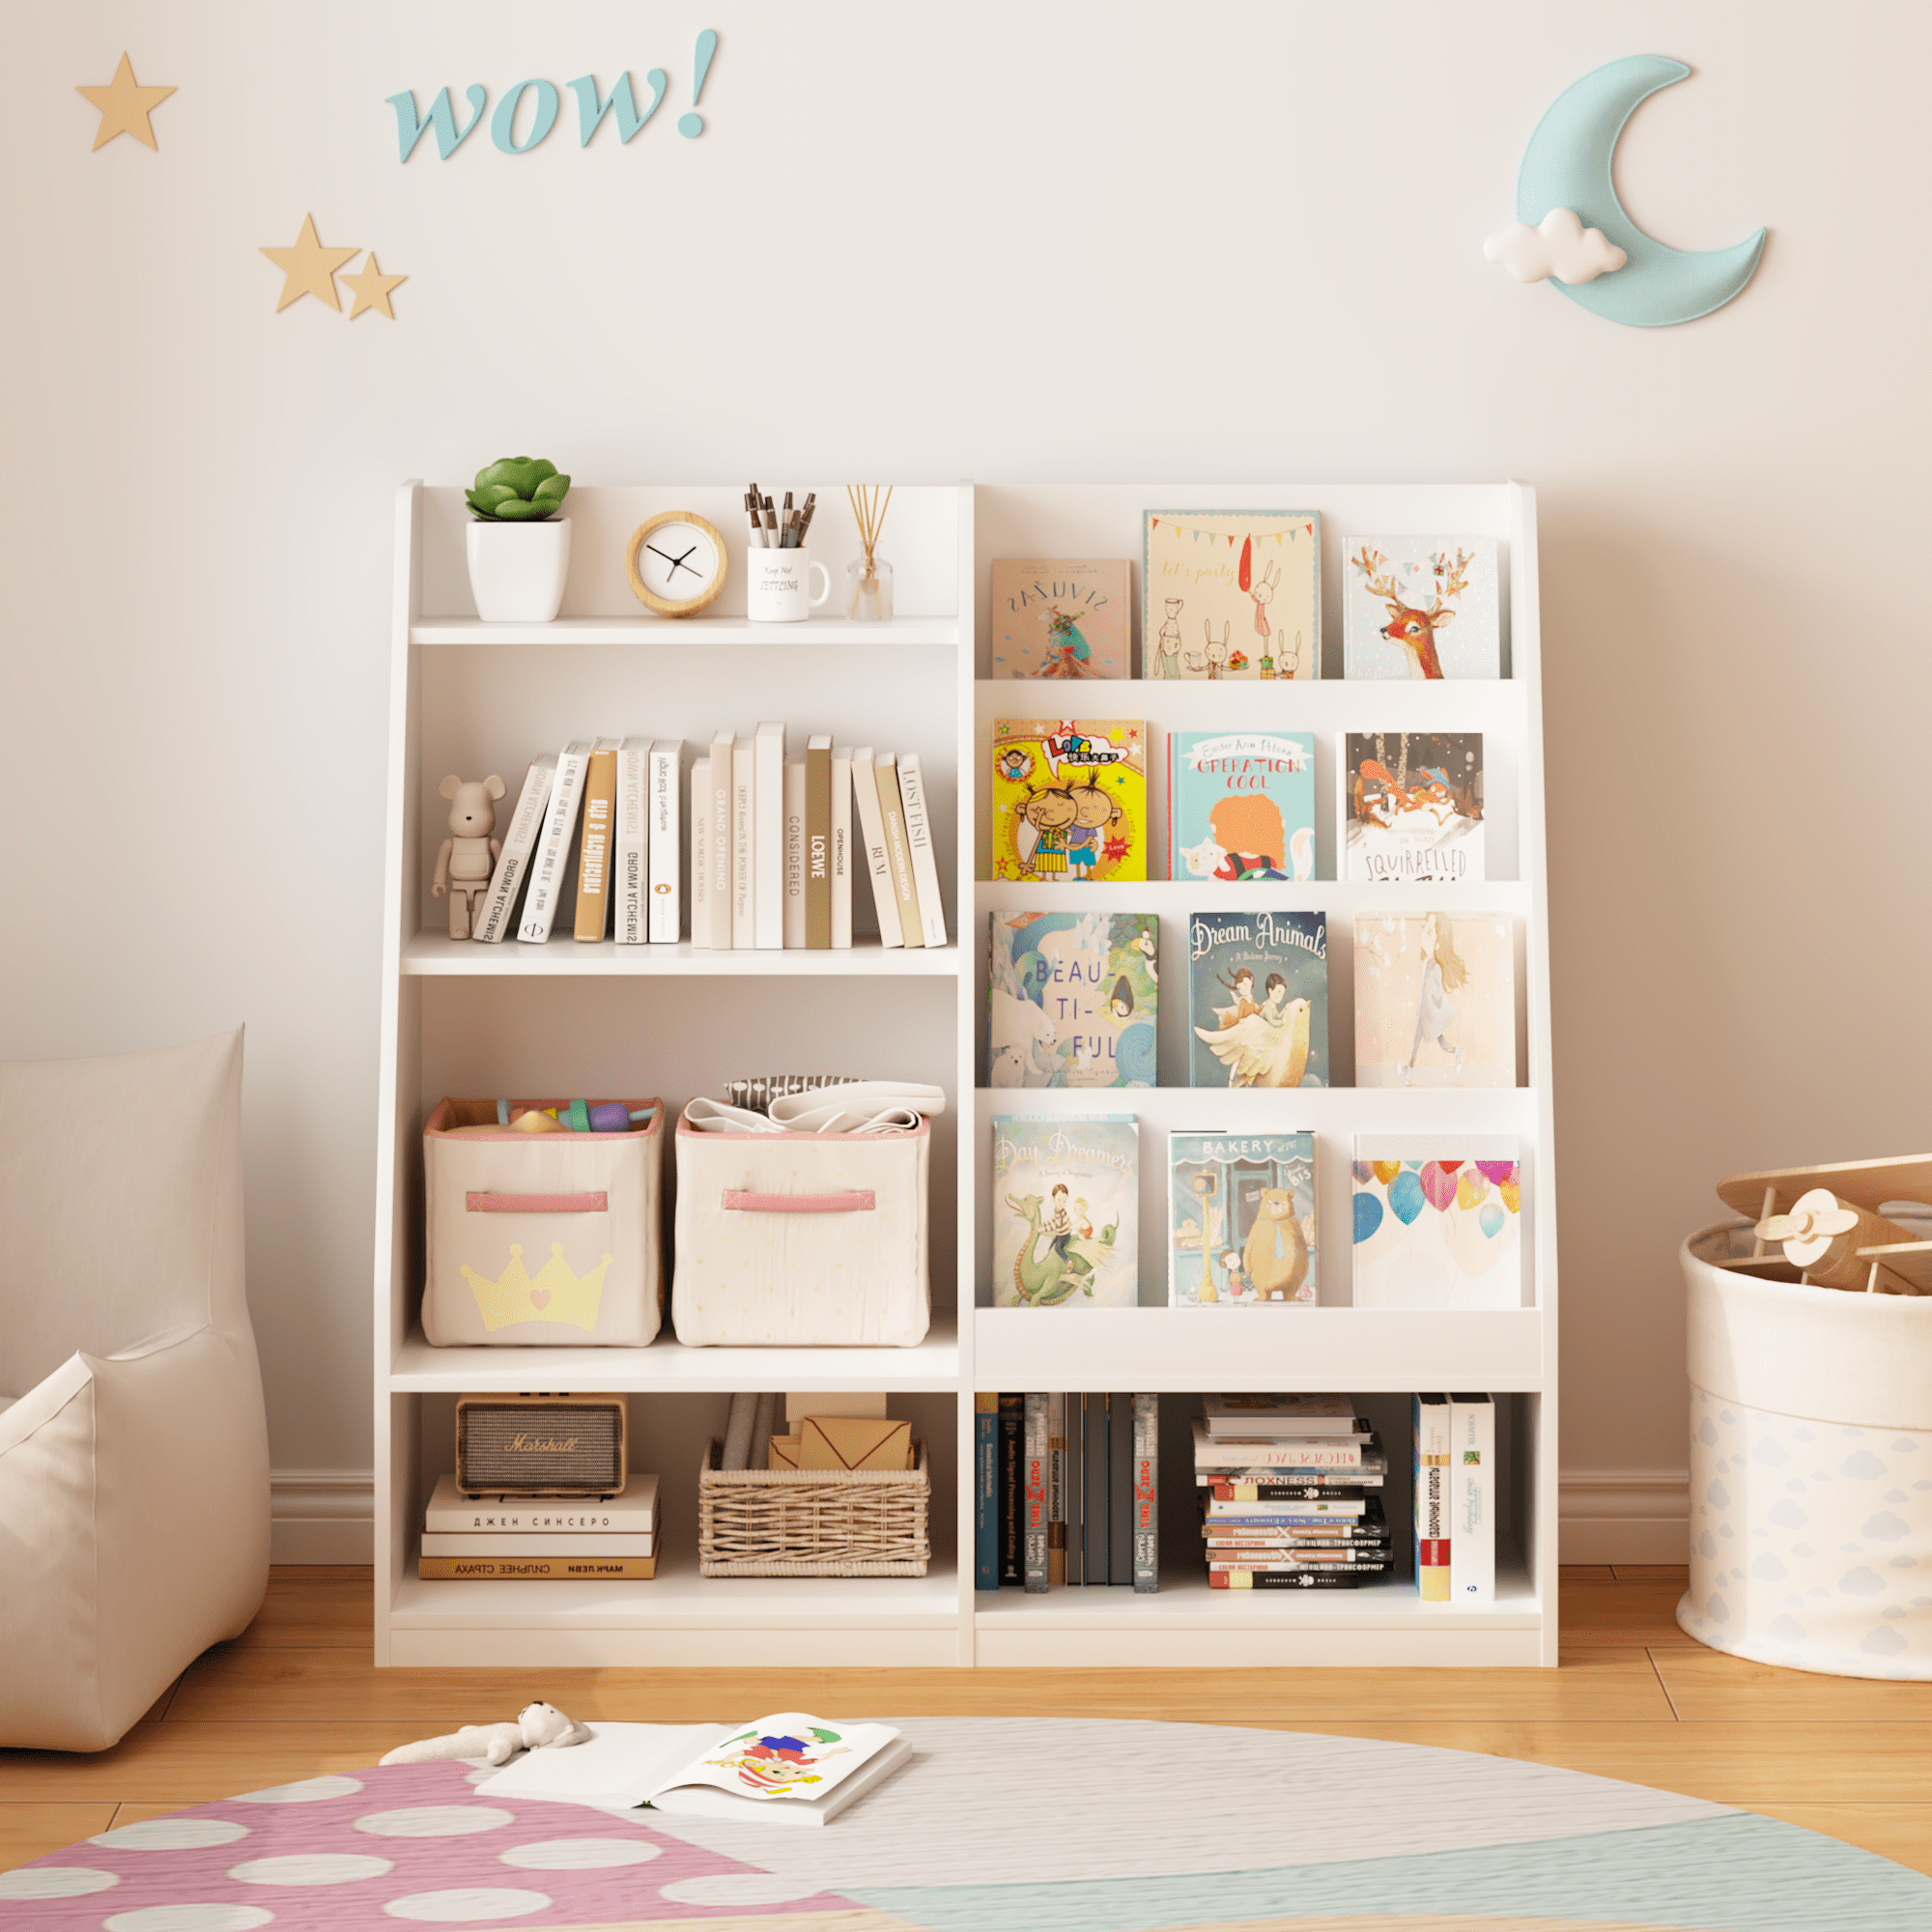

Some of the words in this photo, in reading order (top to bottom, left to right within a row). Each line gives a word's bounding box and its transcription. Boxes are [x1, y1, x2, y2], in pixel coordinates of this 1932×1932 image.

[384, 29, 717, 163] wow!
[1195, 562, 1236, 587] party
[1197, 758, 1301, 774] OPERATION
[902, 770, 921, 810] LOST
[1226, 775, 1271, 790] COOL
[715, 788, 726, 831] GRAND
[888, 811, 902, 839] DANISH
[909, 813, 927, 849] FISH
[715, 836, 726, 892] OPENING
[788, 815, 801, 896] CONSIDERED
[810, 835, 825, 878] LOEWE
[893, 839, 906, 873] MODERN
[1366, 848, 1466, 881] SQUIRRELLED
[898, 874, 911, 901] DESIGN
[1191, 918, 1252, 961] Dream
[1256, 911, 1326, 960] Animals
[1073, 1036, 1116, 1058] FUL
[995, 1135, 1038, 1170] Day
[1045, 1128, 1133, 1176] Dreamers
[1203, 1140, 1274, 1154] BAKERY
[503, 1433, 580, 1452] Marshall
[1007, 1462, 1016, 1482] Signal
[1031, 1461, 1040, 1488] ZERO
[1140, 1461, 1150, 1488] ZERO
[473, 1518, 519, 1527] ДЖЕН
[532, 1518, 610, 1527] СИНСЕРО
[1008, 1520, 1016, 1534] and
[1031, 1504, 1040, 1528] TIME
[1140, 1504, 1150, 1528] TIME
